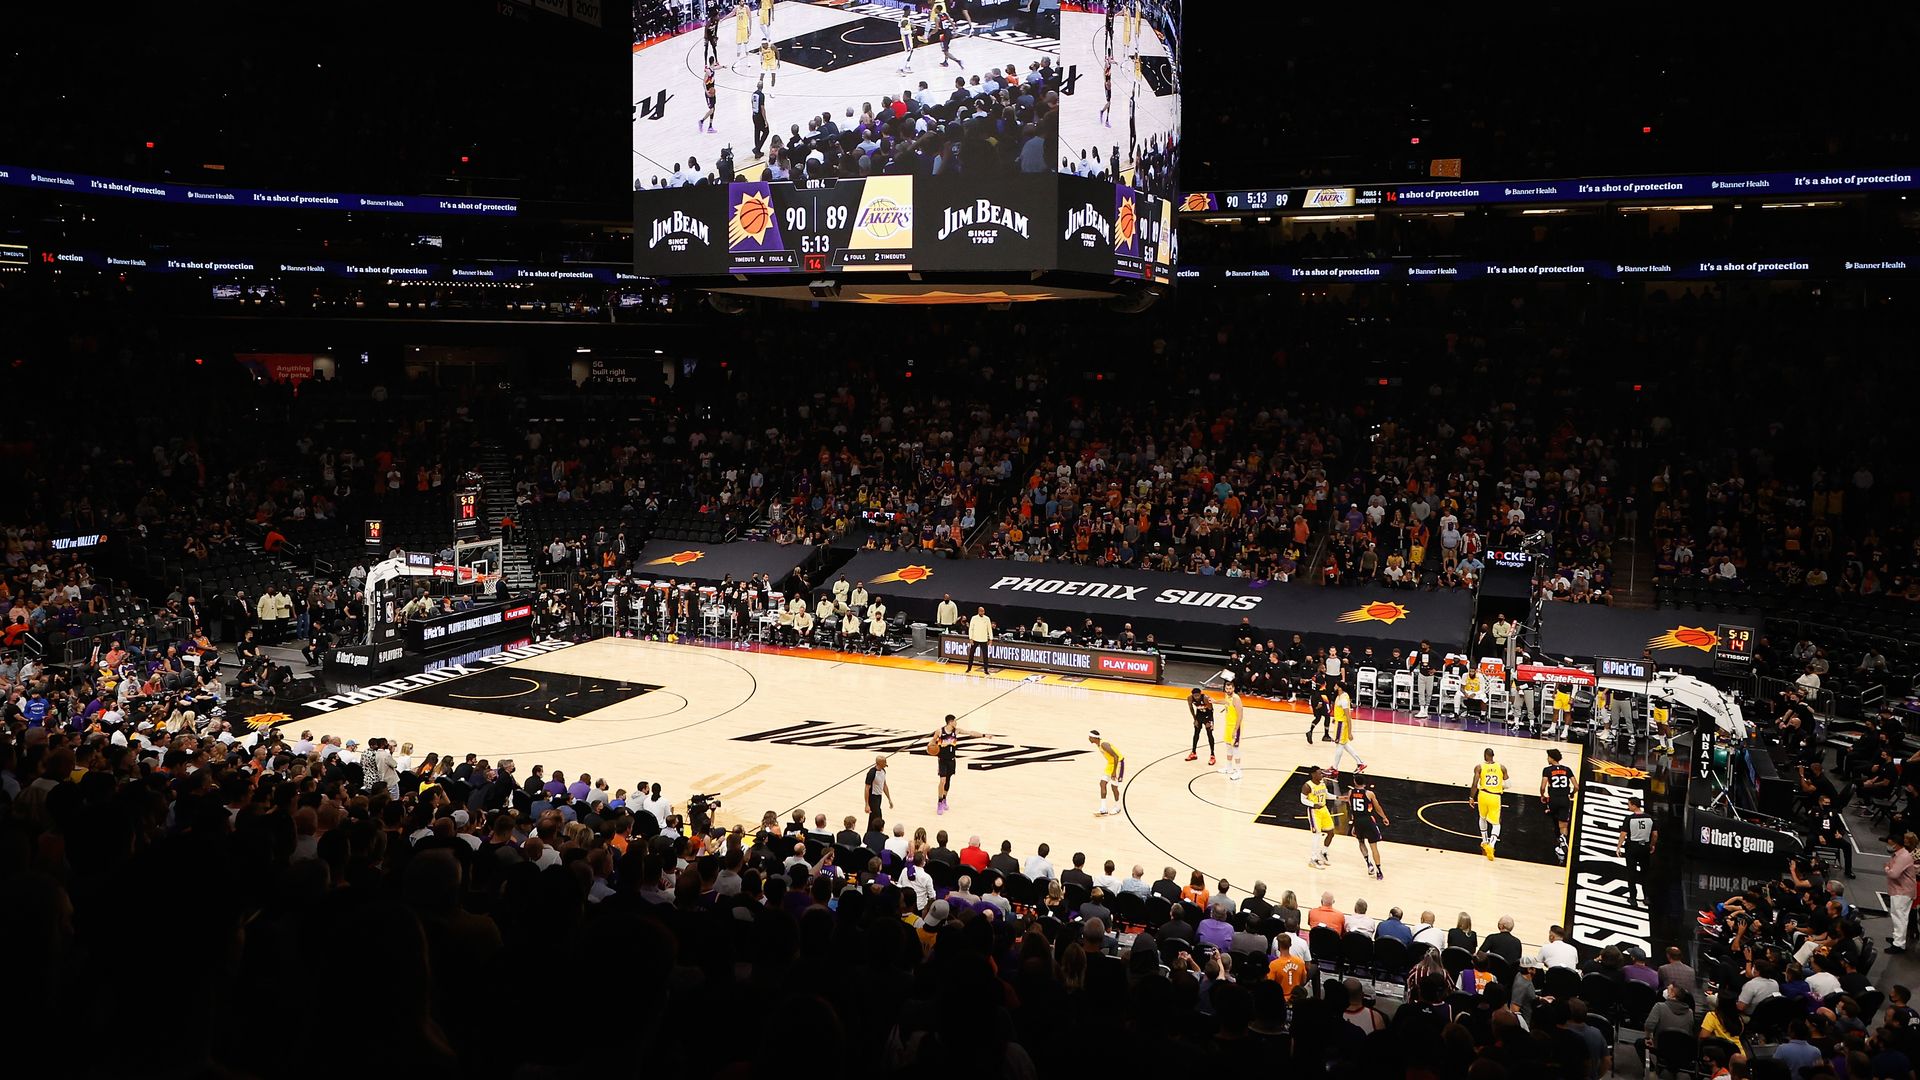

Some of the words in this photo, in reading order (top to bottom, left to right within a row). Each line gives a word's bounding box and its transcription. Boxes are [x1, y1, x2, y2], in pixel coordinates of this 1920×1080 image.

[806, 179, 821, 189] QTR
[821, 179, 826, 189] 4
[1719, 181, 1746, 189] Banner
[1746, 179, 1770, 188] Health
[1794, 176, 1811, 186] It's
[1820, 176, 1843, 185] shot
[1844, 175, 1856, 184] of
[1856, 173, 1912, 186] protection
[91, 180, 103, 189] It's
[108, 182, 124, 191] shot
[123, 184, 132, 192] of
[131, 186, 166, 196] protection
[1512, 187, 1535, 195] Banner
[1535, 186, 1558, 194] Health
[1578, 184, 1594, 193] It's
[1594, 185, 1601, 193] a
[1601, 183, 1622, 193] shot
[1622, 182, 1635, 192] of
[1634, 181, 1683, 193] protection
[253, 193, 266, 201] It's
[272, 194, 290, 202] shot
[290, 195, 300, 203] of
[299, 196, 339, 205] protection
[1247, 192, 1267, 204] 5:13
[1313, 190, 1345, 203] LAKERS
[1405, 190, 1424, 199] shot
[1425, 189, 1436, 198] of
[1434, 188, 1480, 200] protection
[439, 201, 452, 209] It's
[457, 202, 474, 210] shot
[473, 202, 483, 210] of
[1226, 195, 1239, 208] 90
[1276, 194, 1289, 207] 89
[786, 207, 806, 230] 90
[826, 205, 848, 230] 89
[858, 207, 912, 229] LAKERS
[938, 206, 973, 240] JIM
[975, 199, 1030, 239] BEAM
[649, 217, 672, 249] JIM
[673, 210, 711, 246] BEAM
[1064, 207, 1085, 241] JIM
[1085, 203, 1110, 245] BEAM
[967, 229, 998, 237] SINCE
[1080, 232, 1096, 241] SINCE
[802, 235, 830, 253] 5:13
[167, 260, 181, 268] It's
[186, 261, 204, 269] shot
[204, 261, 214, 269] of
[213, 262, 254, 271] protection
[346, 265, 359, 273] It's
[364, 265, 381, 274] shot
[381, 266, 390, 274] of
[390, 267, 428, 275] protection
[809, 259, 822, 270] 14
[1486, 265, 1501, 274] It's
[1508, 265, 1528, 274] shot
[1528, 264, 1539, 273] of
[1538, 265, 1585, 275] protection
[1624, 265, 1649, 273] Banner
[1648, 264, 1672, 272] Health
[1699, 262, 1715, 271] It's
[1723, 262, 1745, 271] shot
[1745, 262, 1758, 271] of
[1757, 261, 1809, 273] protection
[1853, 261, 1882, 269] Banner
[1881, 261, 1906, 269] Health
[517, 269, 529, 277] It's
[534, 270, 550, 278] shot
[550, 270, 559, 278] of
[558, 271, 594, 279] protection
[1291, 268, 1305, 276] It's
[1311, 268, 1329, 276] shot
[1328, 267, 1339, 276] of
[1338, 267, 1380, 278] protection
[862, 510, 896, 520] ROCET
[77, 534, 99, 547] VALLEY
[1495, 560, 1525, 568] Mortgage
[989, 576, 1148, 601] PHOENIX
[1154, 588, 1262, 611] SUNS
[376, 609, 381, 621] TV
[507, 610, 518, 619] PLAY
[1729, 629, 1749, 641] 5:13
[1731, 640, 1744, 651] 14
[951, 640, 981, 657] Pick'm
[987, 645, 1020, 662] PLAYOFFS
[1020, 648, 1051, 665] BRACKET
[1052, 651, 1091, 669] CHALLENGE
[1103, 659, 1126, 670] PLAY
[1127, 662, 1149, 672] NOW
[1727, 653, 1750, 661] TISSOT
[1610, 660, 1645, 677] Pick'Em
[300, 663, 485, 713] PHOENIX
[479, 638, 575, 666] SUNS
[1700, 733, 1711, 759] NBA
[1700, 761, 1710, 779] TV
[1485, 774, 1499, 786] 23
[1551, 775, 1568, 788] 23
[1352, 798, 1365, 812] 15
[1638, 820, 1646, 830] 15
[1710, 828, 1741, 849] that's
[1742, 837, 1774, 854] game
